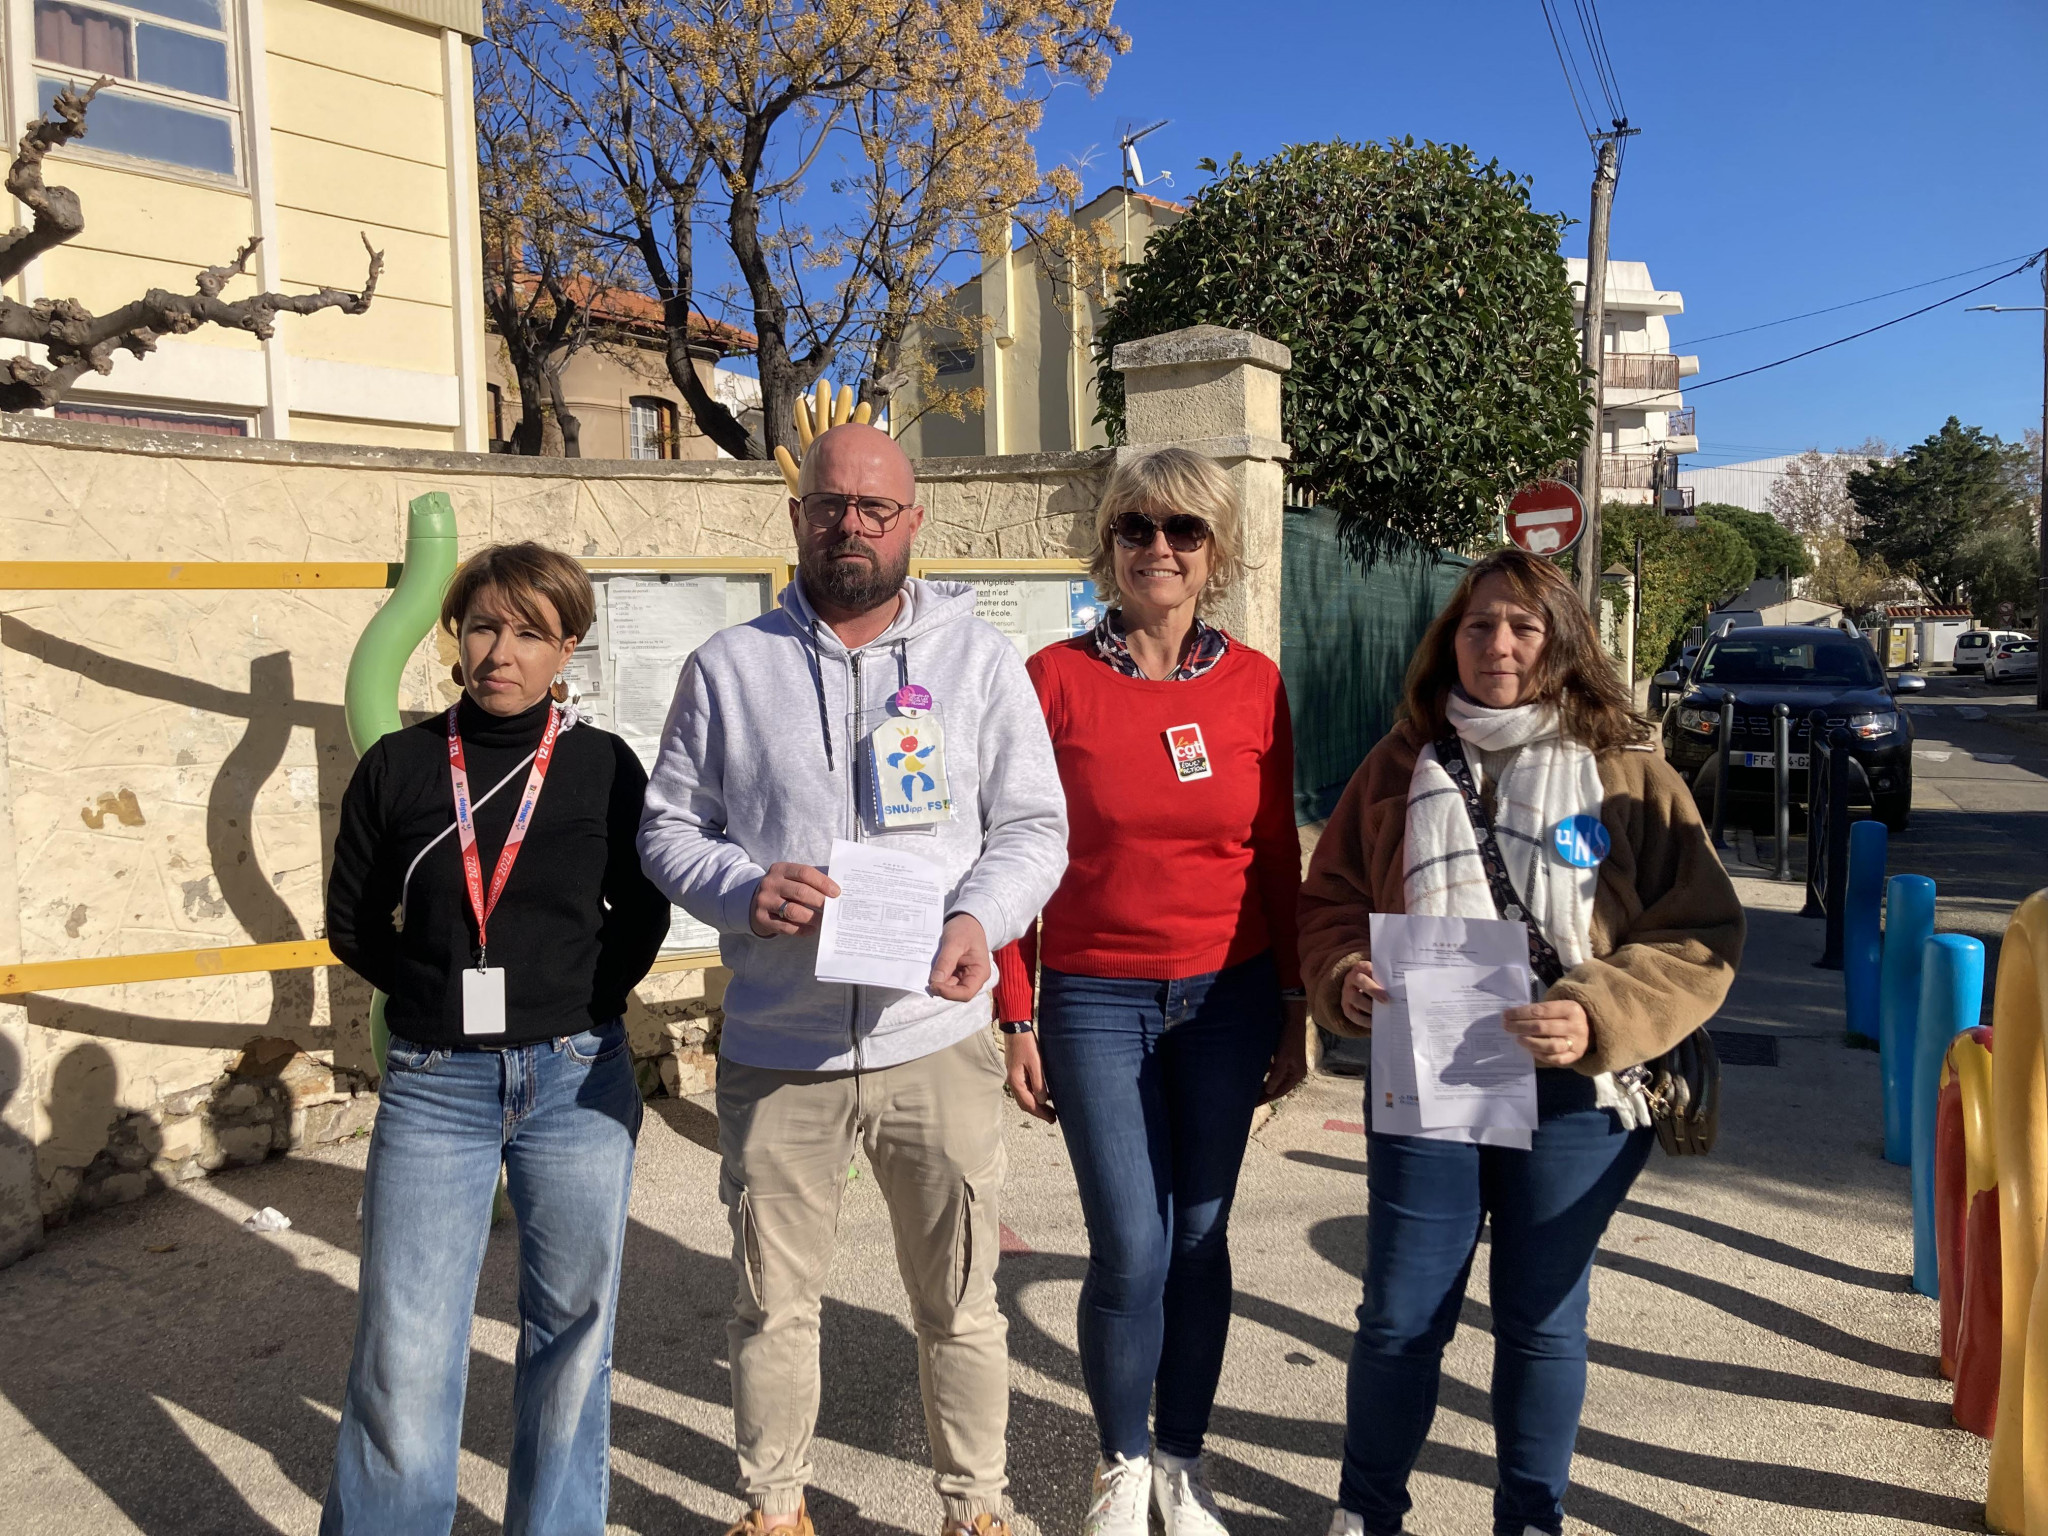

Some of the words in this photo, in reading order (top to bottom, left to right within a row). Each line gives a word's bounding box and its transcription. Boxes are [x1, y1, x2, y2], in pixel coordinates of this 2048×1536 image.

[976, 589, 990, 597] rent
[987, 608, 1012, 617] l'école.
[1176, 741, 1203, 759] cgt
[466, 855, 478, 878] 2022
[498, 851, 513, 877] 2022
